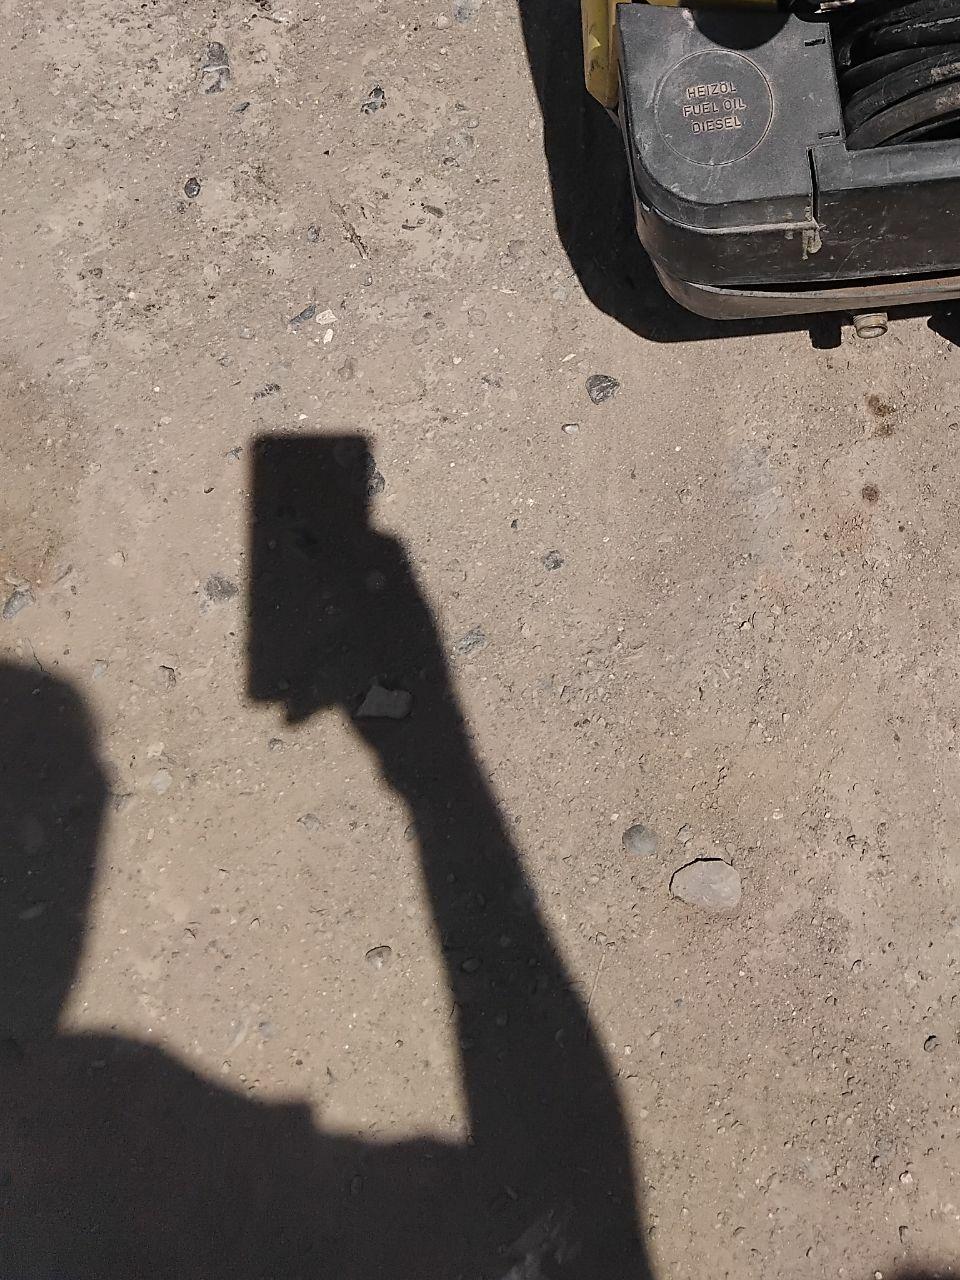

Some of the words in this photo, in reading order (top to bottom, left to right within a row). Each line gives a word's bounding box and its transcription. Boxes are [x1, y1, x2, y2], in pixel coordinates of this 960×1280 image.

[683, 102, 719, 117] FUEL
[723, 98, 747, 111] OIL
[692, 116, 741, 134] DIESEL
